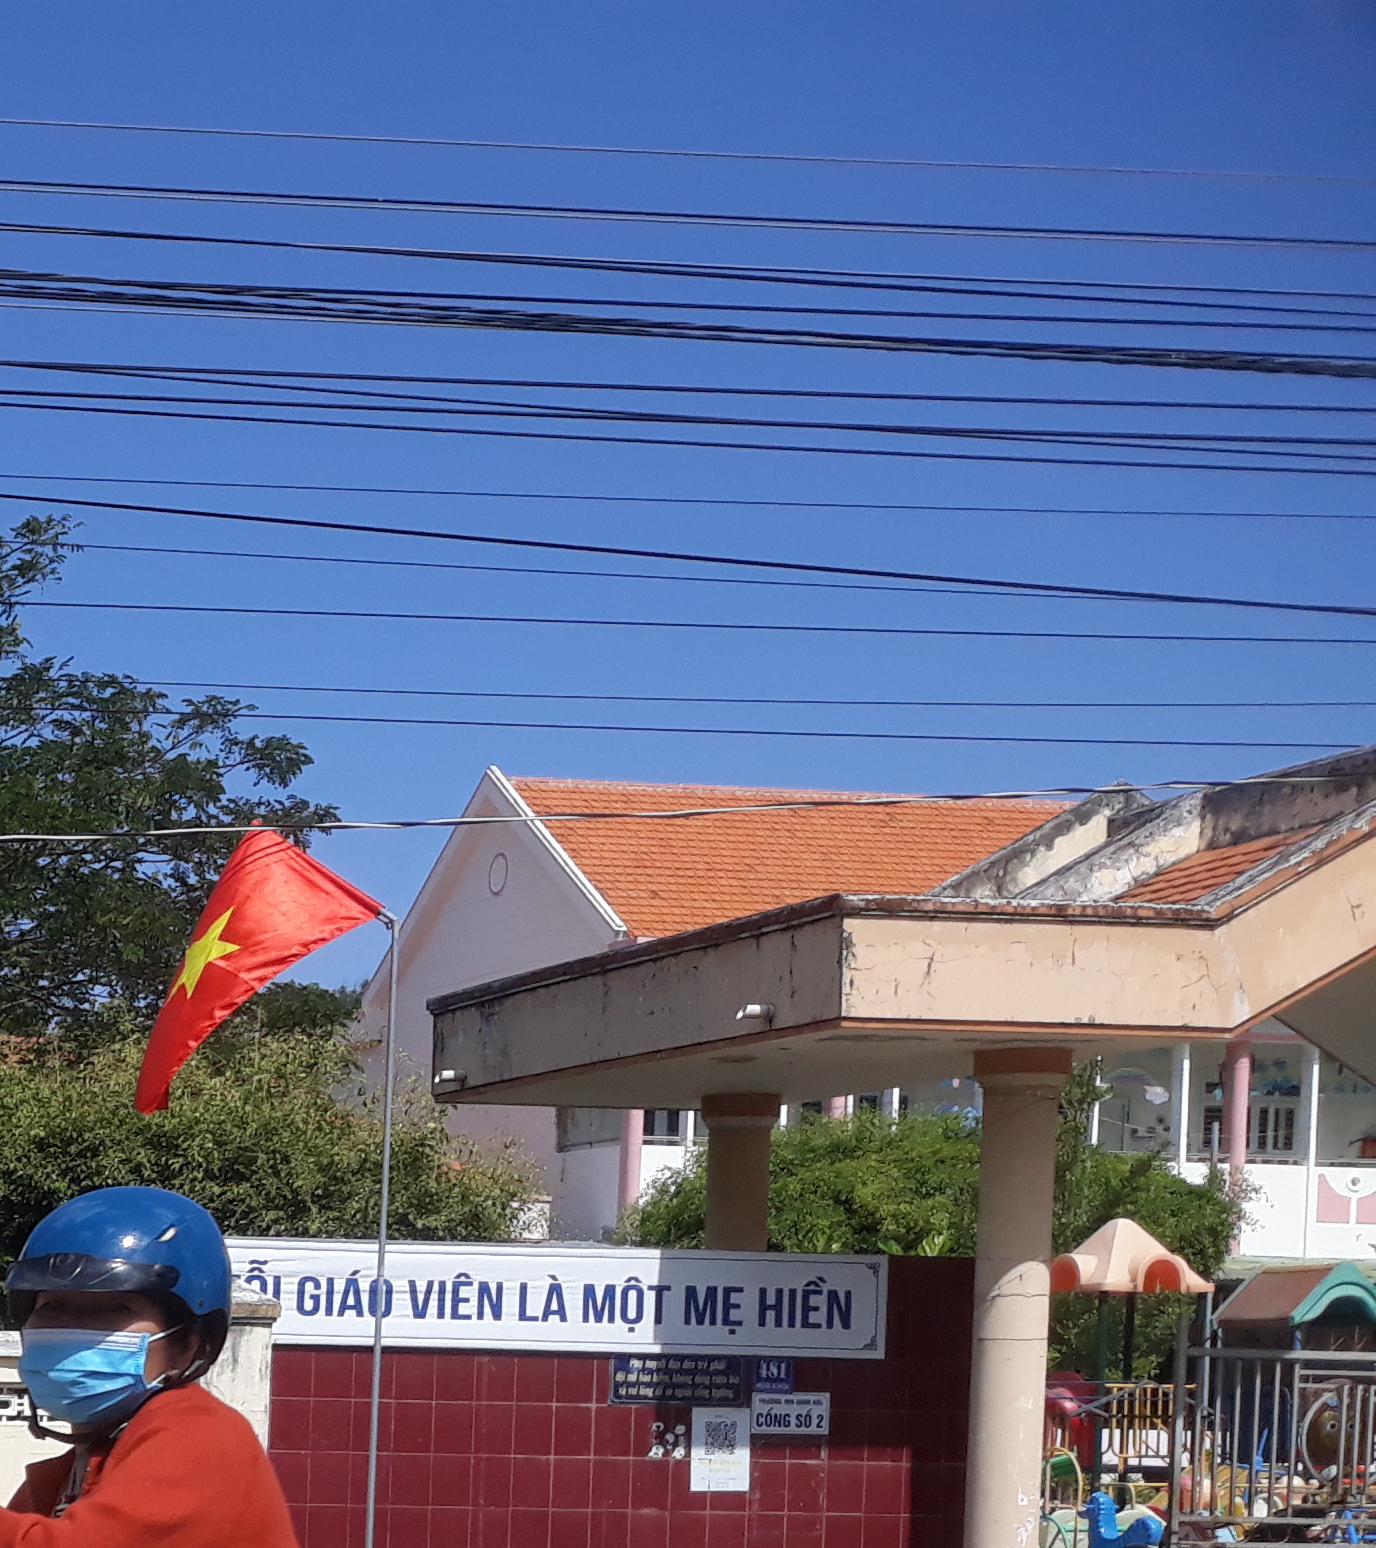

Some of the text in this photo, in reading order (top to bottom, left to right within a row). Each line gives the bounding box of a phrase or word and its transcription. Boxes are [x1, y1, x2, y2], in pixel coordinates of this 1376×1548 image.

[296, 1269, 393, 1319] GIÁO
[407, 1272, 504, 1321] VIÊN
[517, 1274, 569, 1323] LÀ
[582, 1276, 672, 1333] MỘT
[683, 1285, 745, 1335] MẸ
[757, 1276, 853, 1330] HIỀN
[758, 1360, 787, 1379] 481
[795, 1408, 813, 1428] SỐ
[816, 1413, 824, 1428] 2
